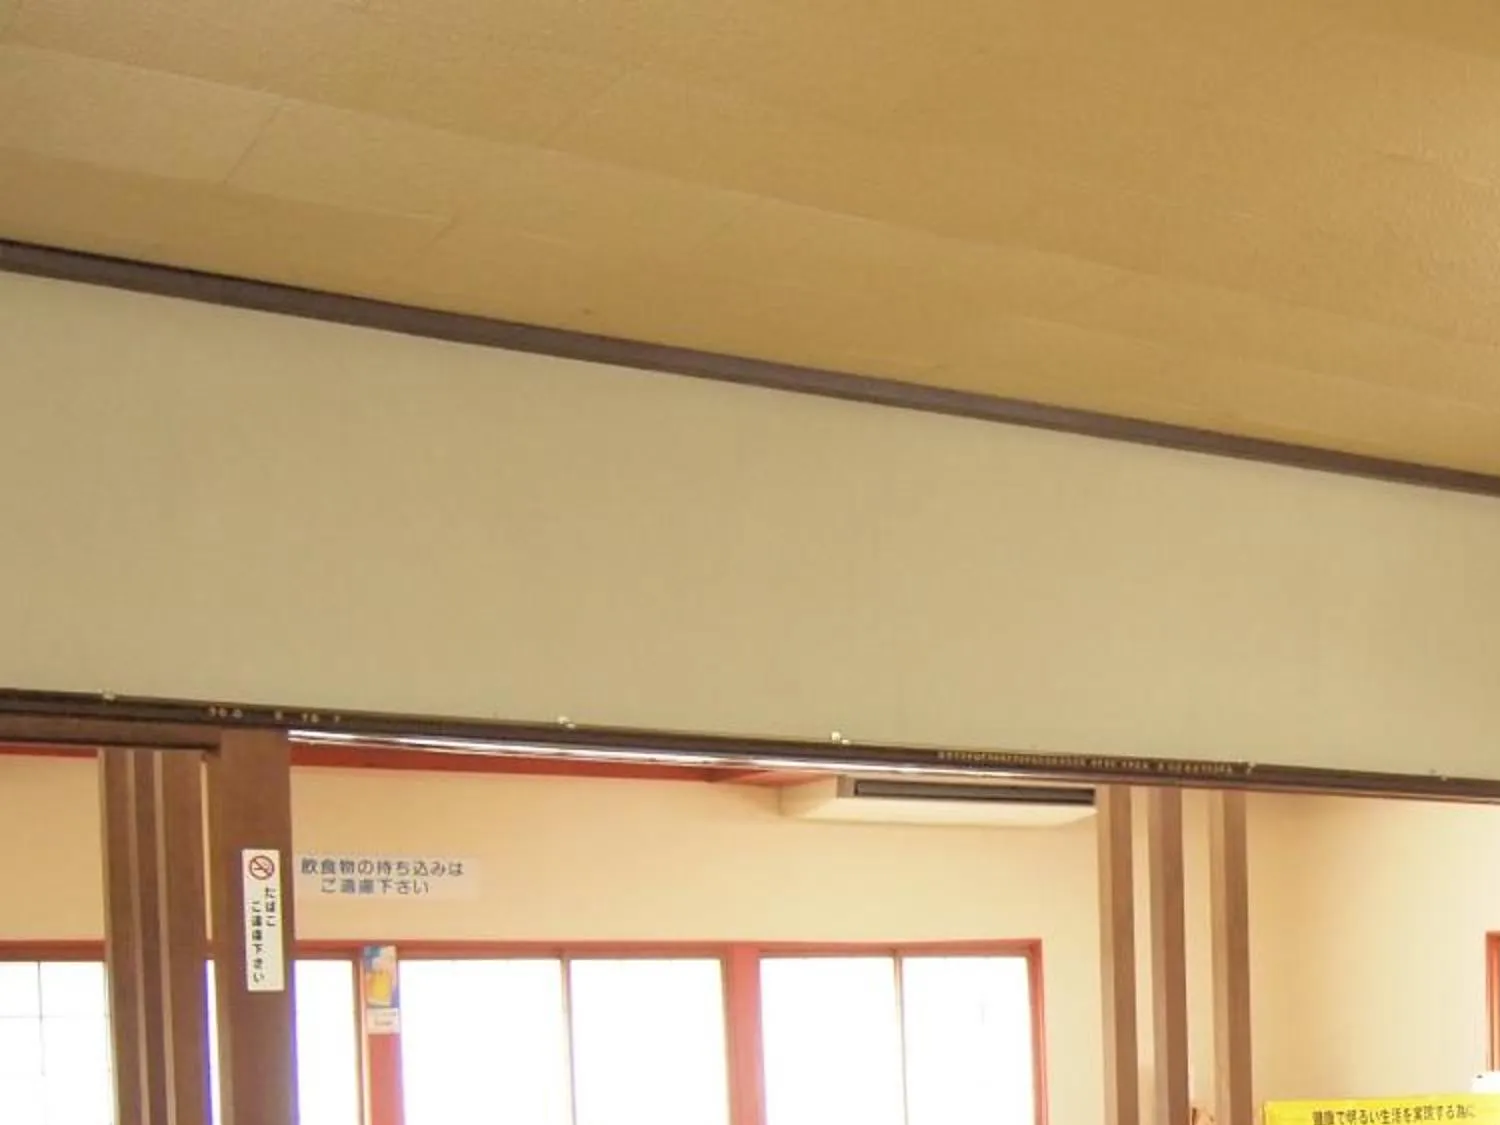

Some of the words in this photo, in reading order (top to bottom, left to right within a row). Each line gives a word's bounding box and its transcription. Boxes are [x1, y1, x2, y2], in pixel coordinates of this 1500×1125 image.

[301, 857, 465, 876] 飲食物の持ち込みは
